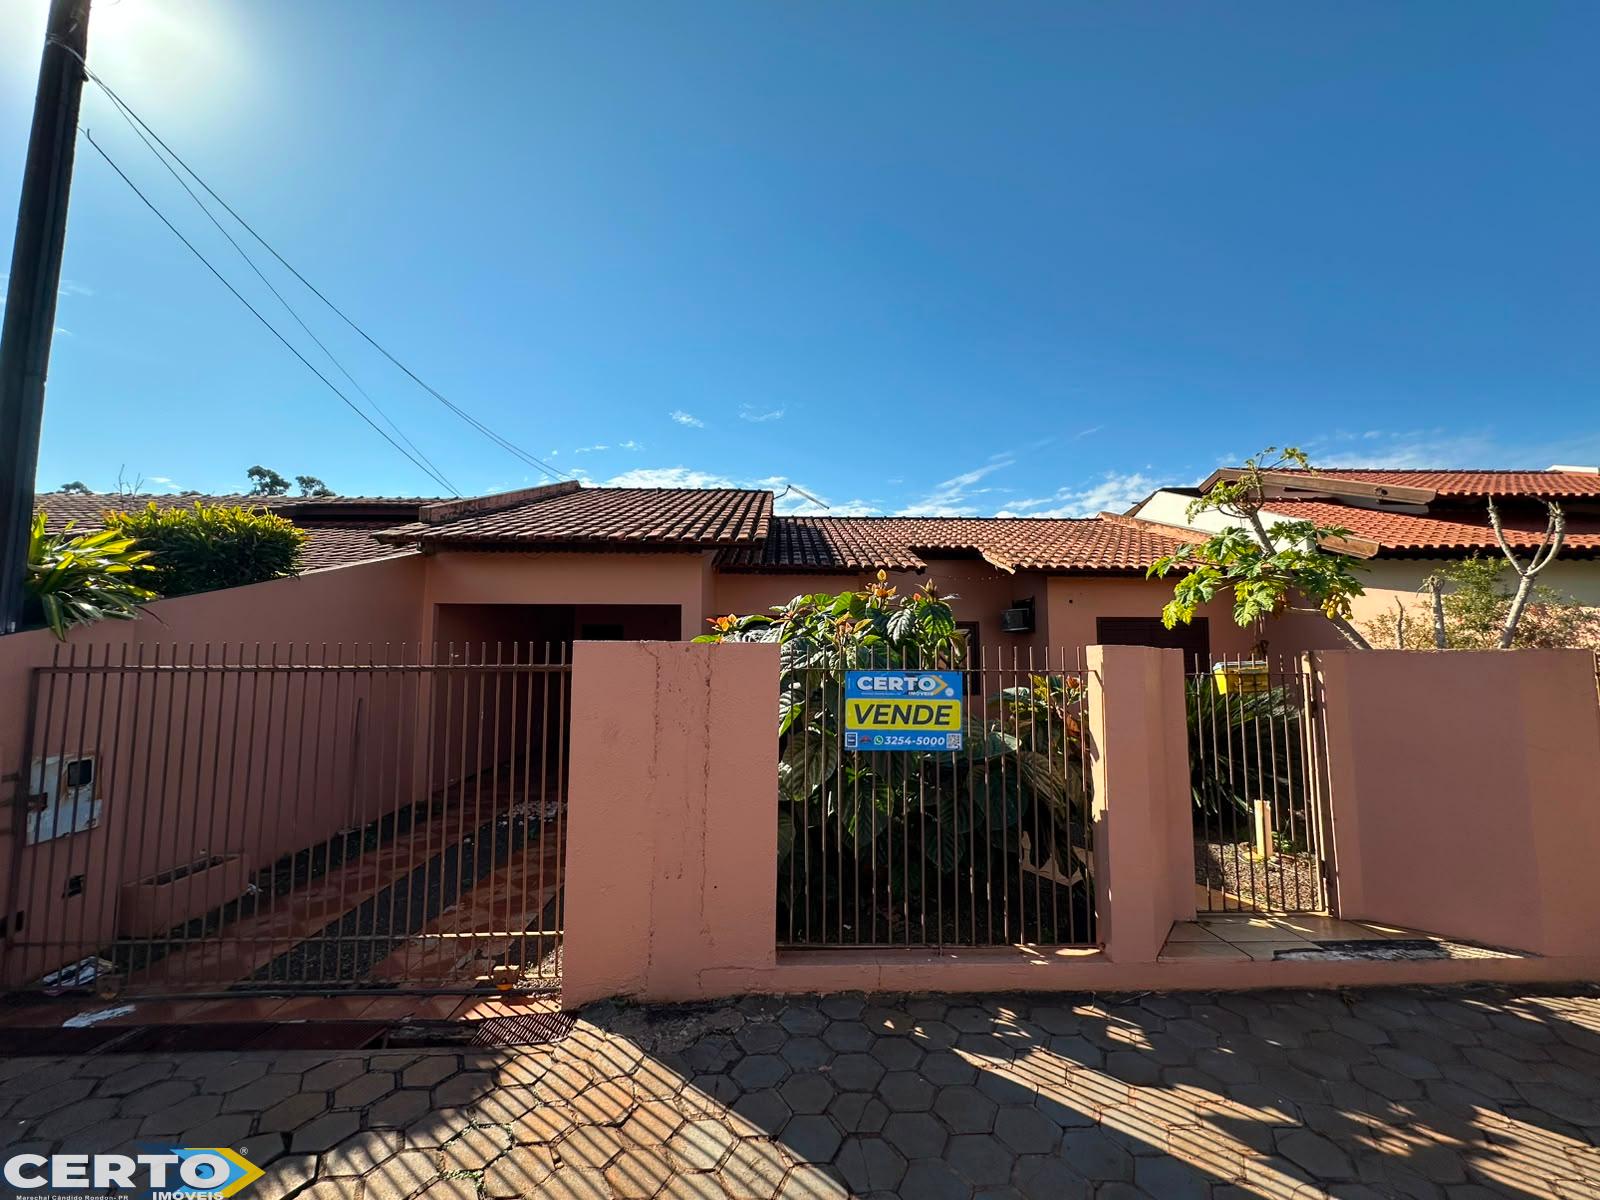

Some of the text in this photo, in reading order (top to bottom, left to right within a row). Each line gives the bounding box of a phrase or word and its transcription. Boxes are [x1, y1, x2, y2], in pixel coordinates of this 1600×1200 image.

[857, 676, 936, 691] CERTO
[854, 704, 953, 725] VENDE
[885, 736, 945, 745] 3254-5000
